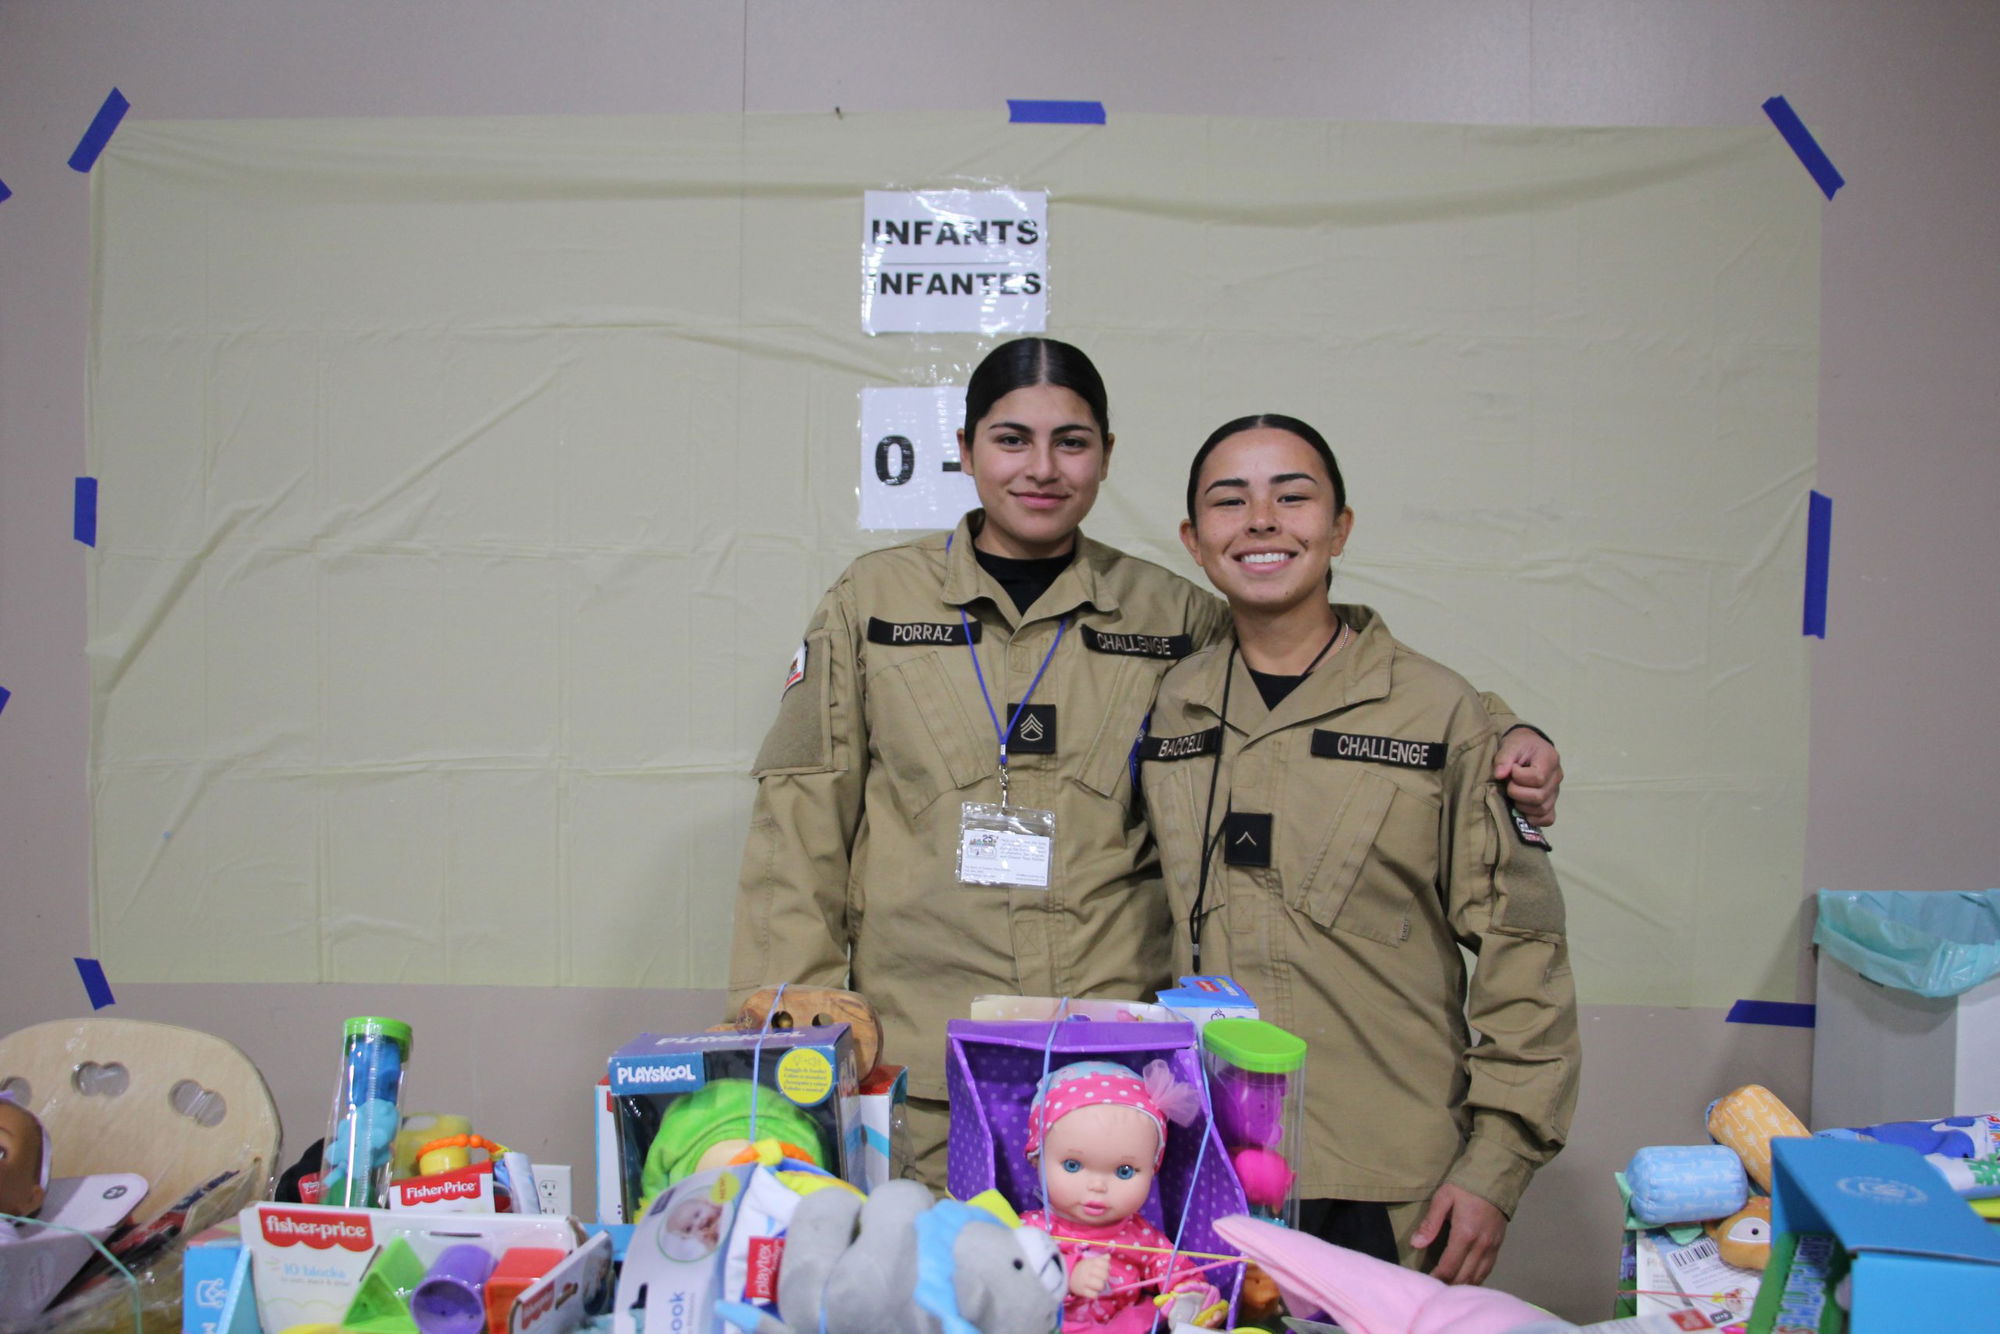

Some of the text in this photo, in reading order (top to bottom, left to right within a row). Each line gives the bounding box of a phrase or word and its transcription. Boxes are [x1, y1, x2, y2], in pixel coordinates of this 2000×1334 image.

[872, 219, 1039, 245] INFANTS
[875, 435, 915, 486] 0
[892, 623, 953, 643] PORRAZ
[1096, 632, 1170, 656] CHALLENGE
[1158, 732, 1206, 758] BACCELLI
[1337, 734, 1430, 766] CHALLENGE
[617, 1064, 697, 1085] PLAYSKOOL
[406, 1181, 475, 1199] Fisher-Price
[265, 1215, 366, 1239] fisher-price
[753, 1243, 773, 1298] playtex
[669, 1291, 686, 1334] ook
